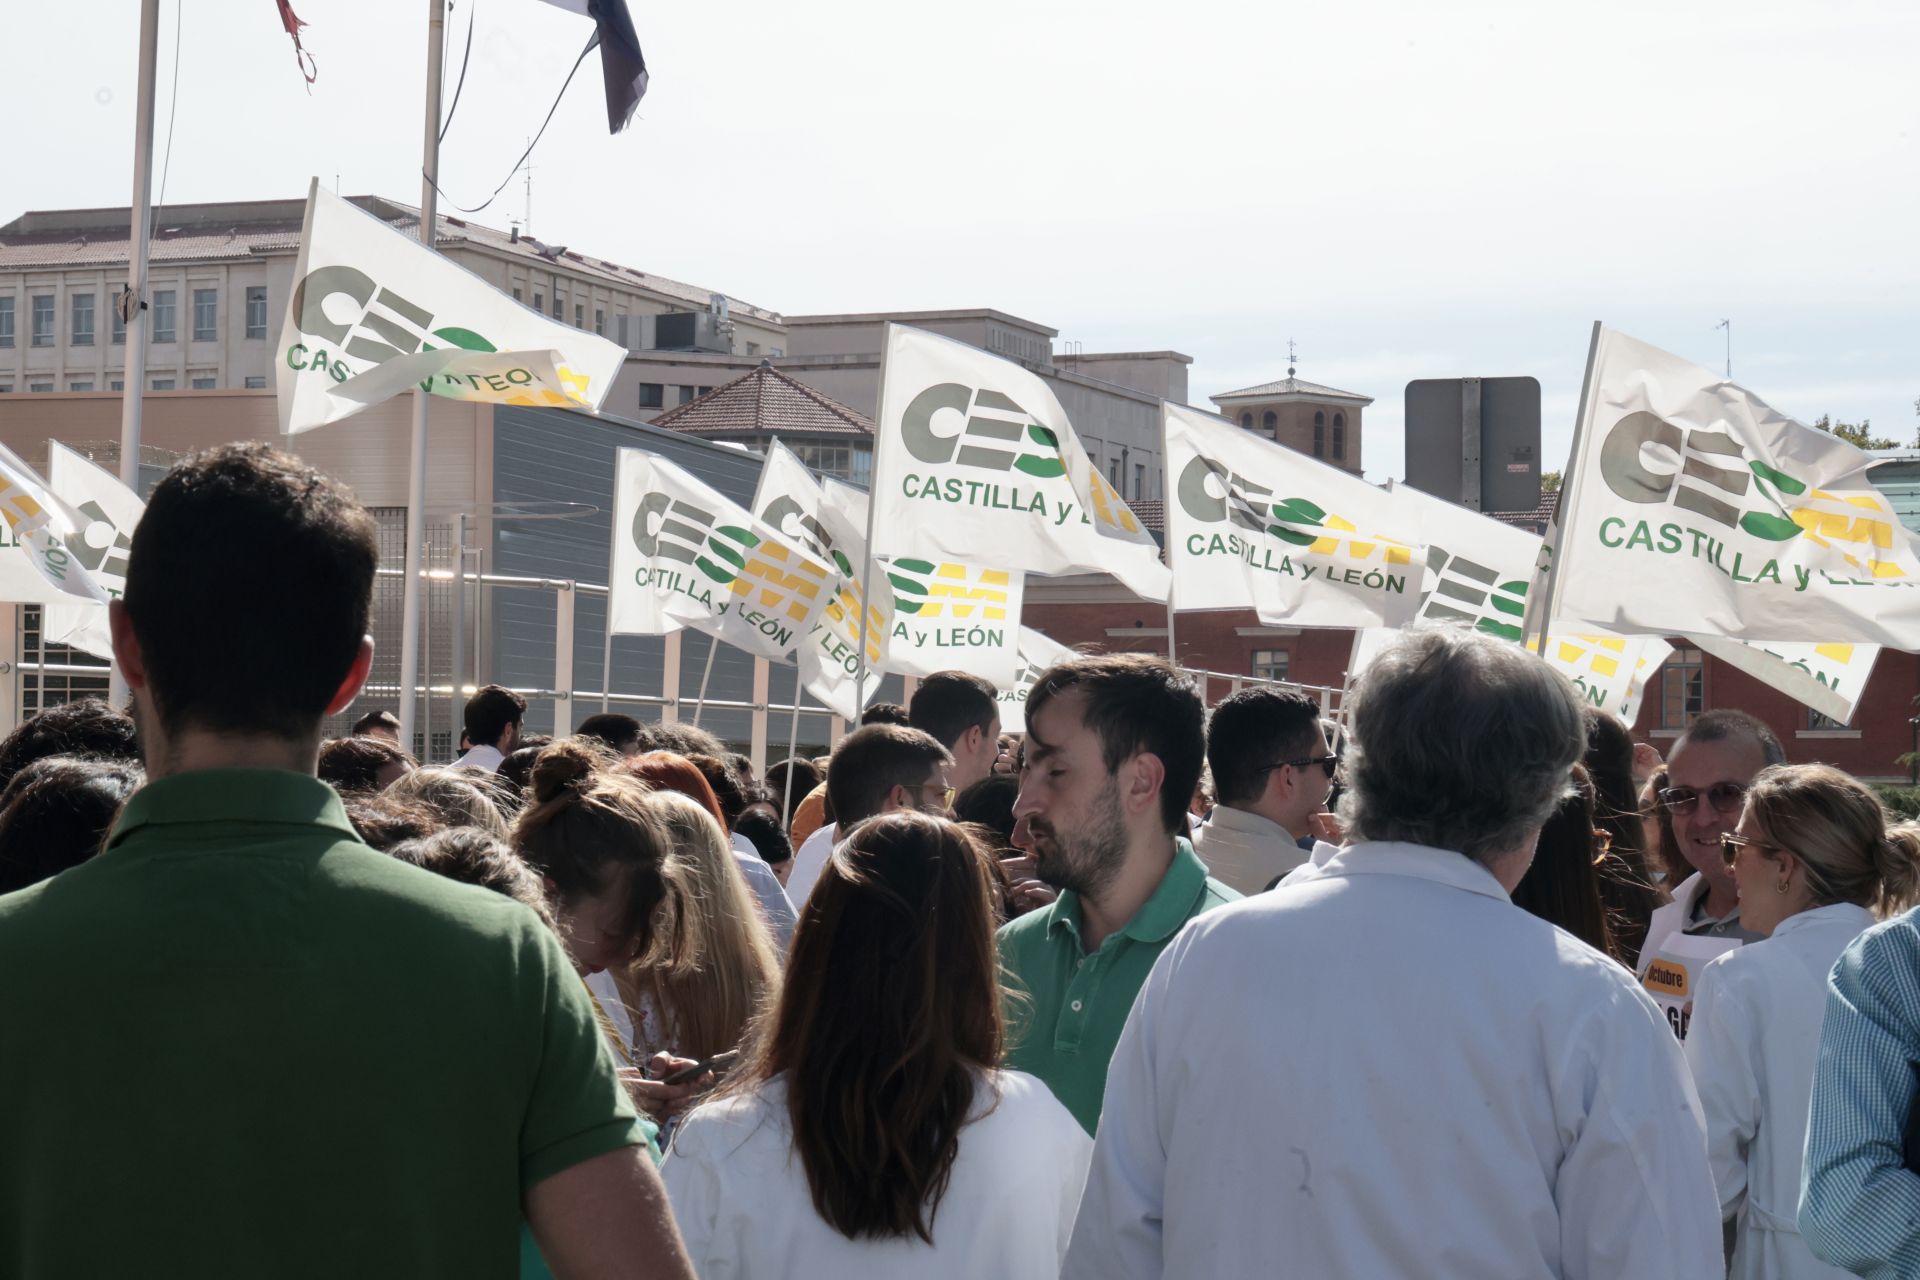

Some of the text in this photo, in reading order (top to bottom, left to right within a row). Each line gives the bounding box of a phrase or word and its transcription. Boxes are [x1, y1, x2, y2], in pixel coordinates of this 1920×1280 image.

[902, 474, 1073, 526] CASTILLA y
[1187, 534, 1406, 594] CASTILLA y LEÓN
[1599, 517, 1781, 585] CASTILLA
[1794, 564, 1810, 592] y
[718, 602, 730, 615] y
[739, 603, 793, 646] LEÓN
[916, 630, 928, 648] y
[937, 625, 1003, 648] LEÓN
